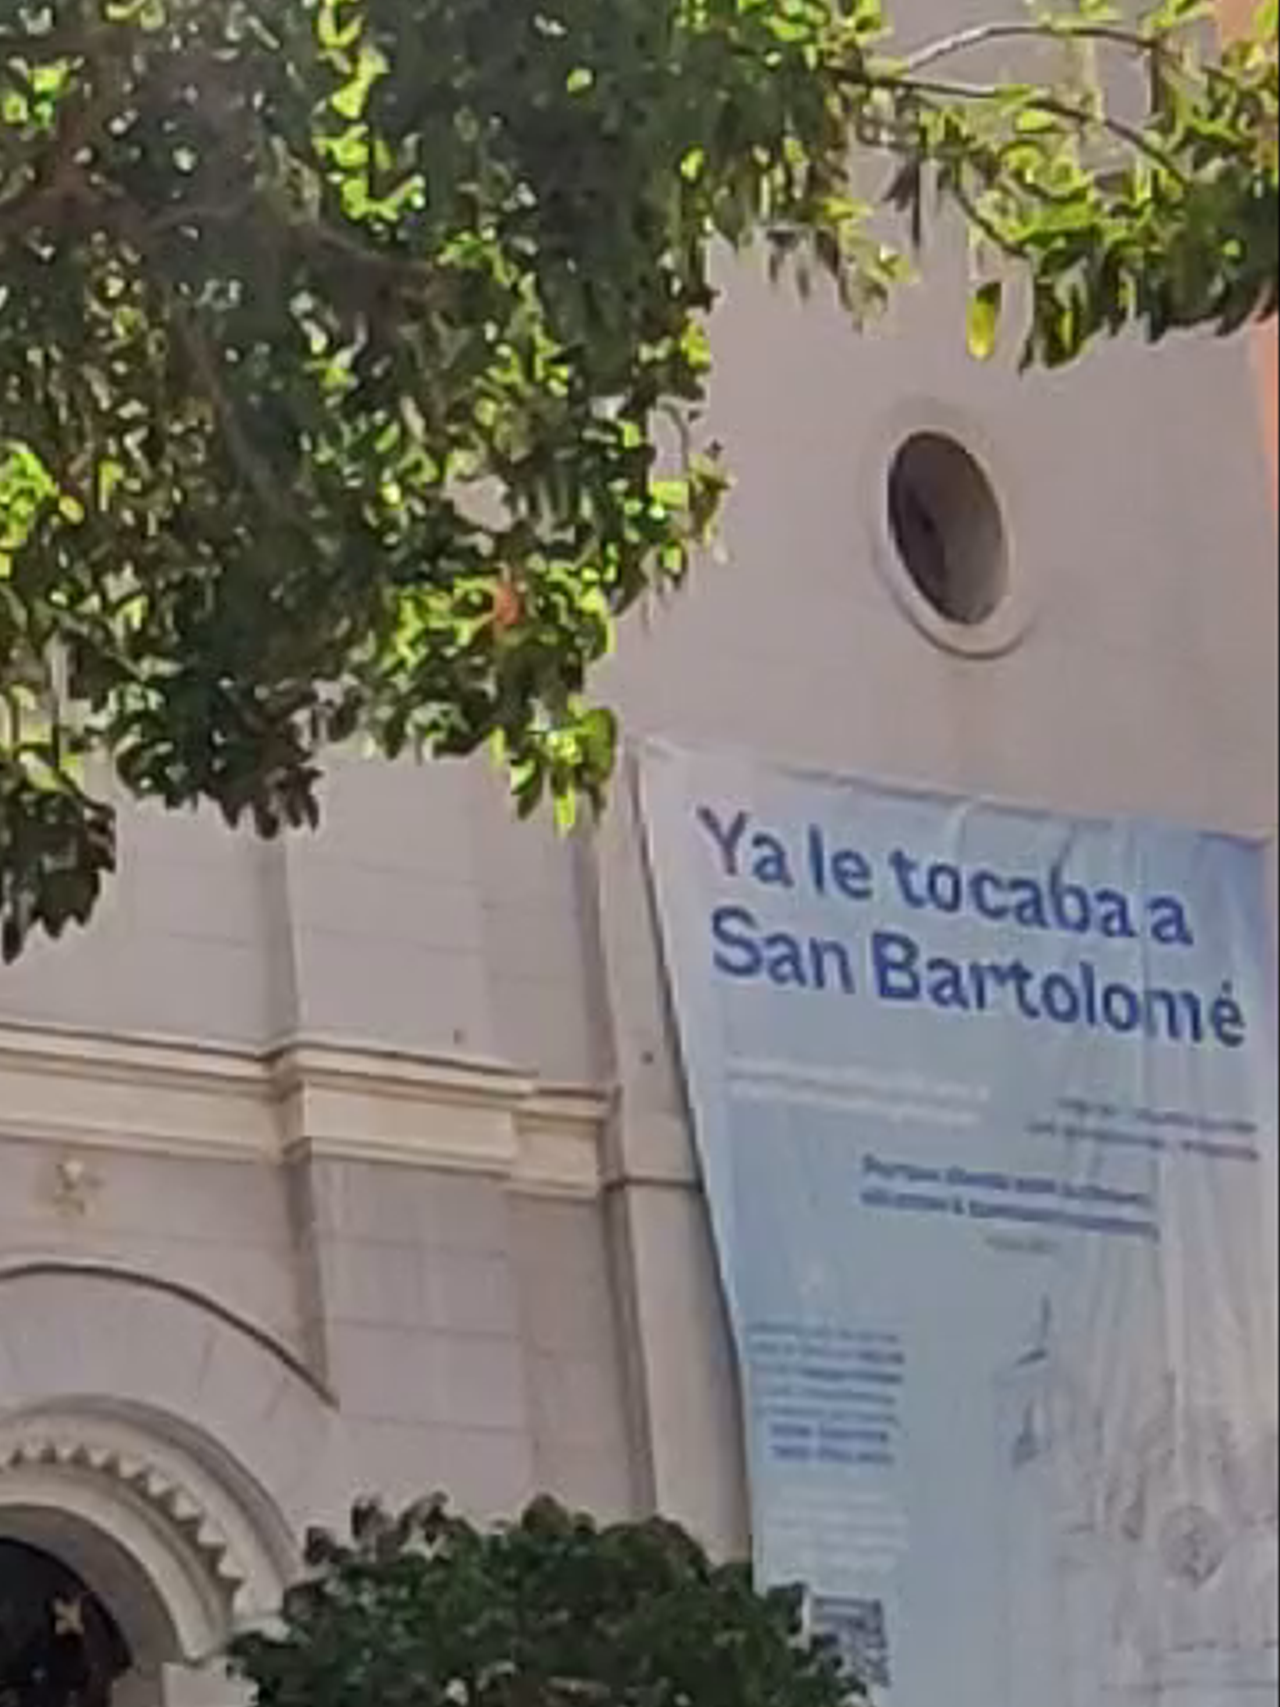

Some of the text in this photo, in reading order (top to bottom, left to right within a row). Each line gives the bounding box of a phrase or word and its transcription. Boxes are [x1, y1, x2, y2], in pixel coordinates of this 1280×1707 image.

[697, 807, 1194, 946] Ya le tocaba a
[711, 906, 1247, 1046] San Bartolomé
